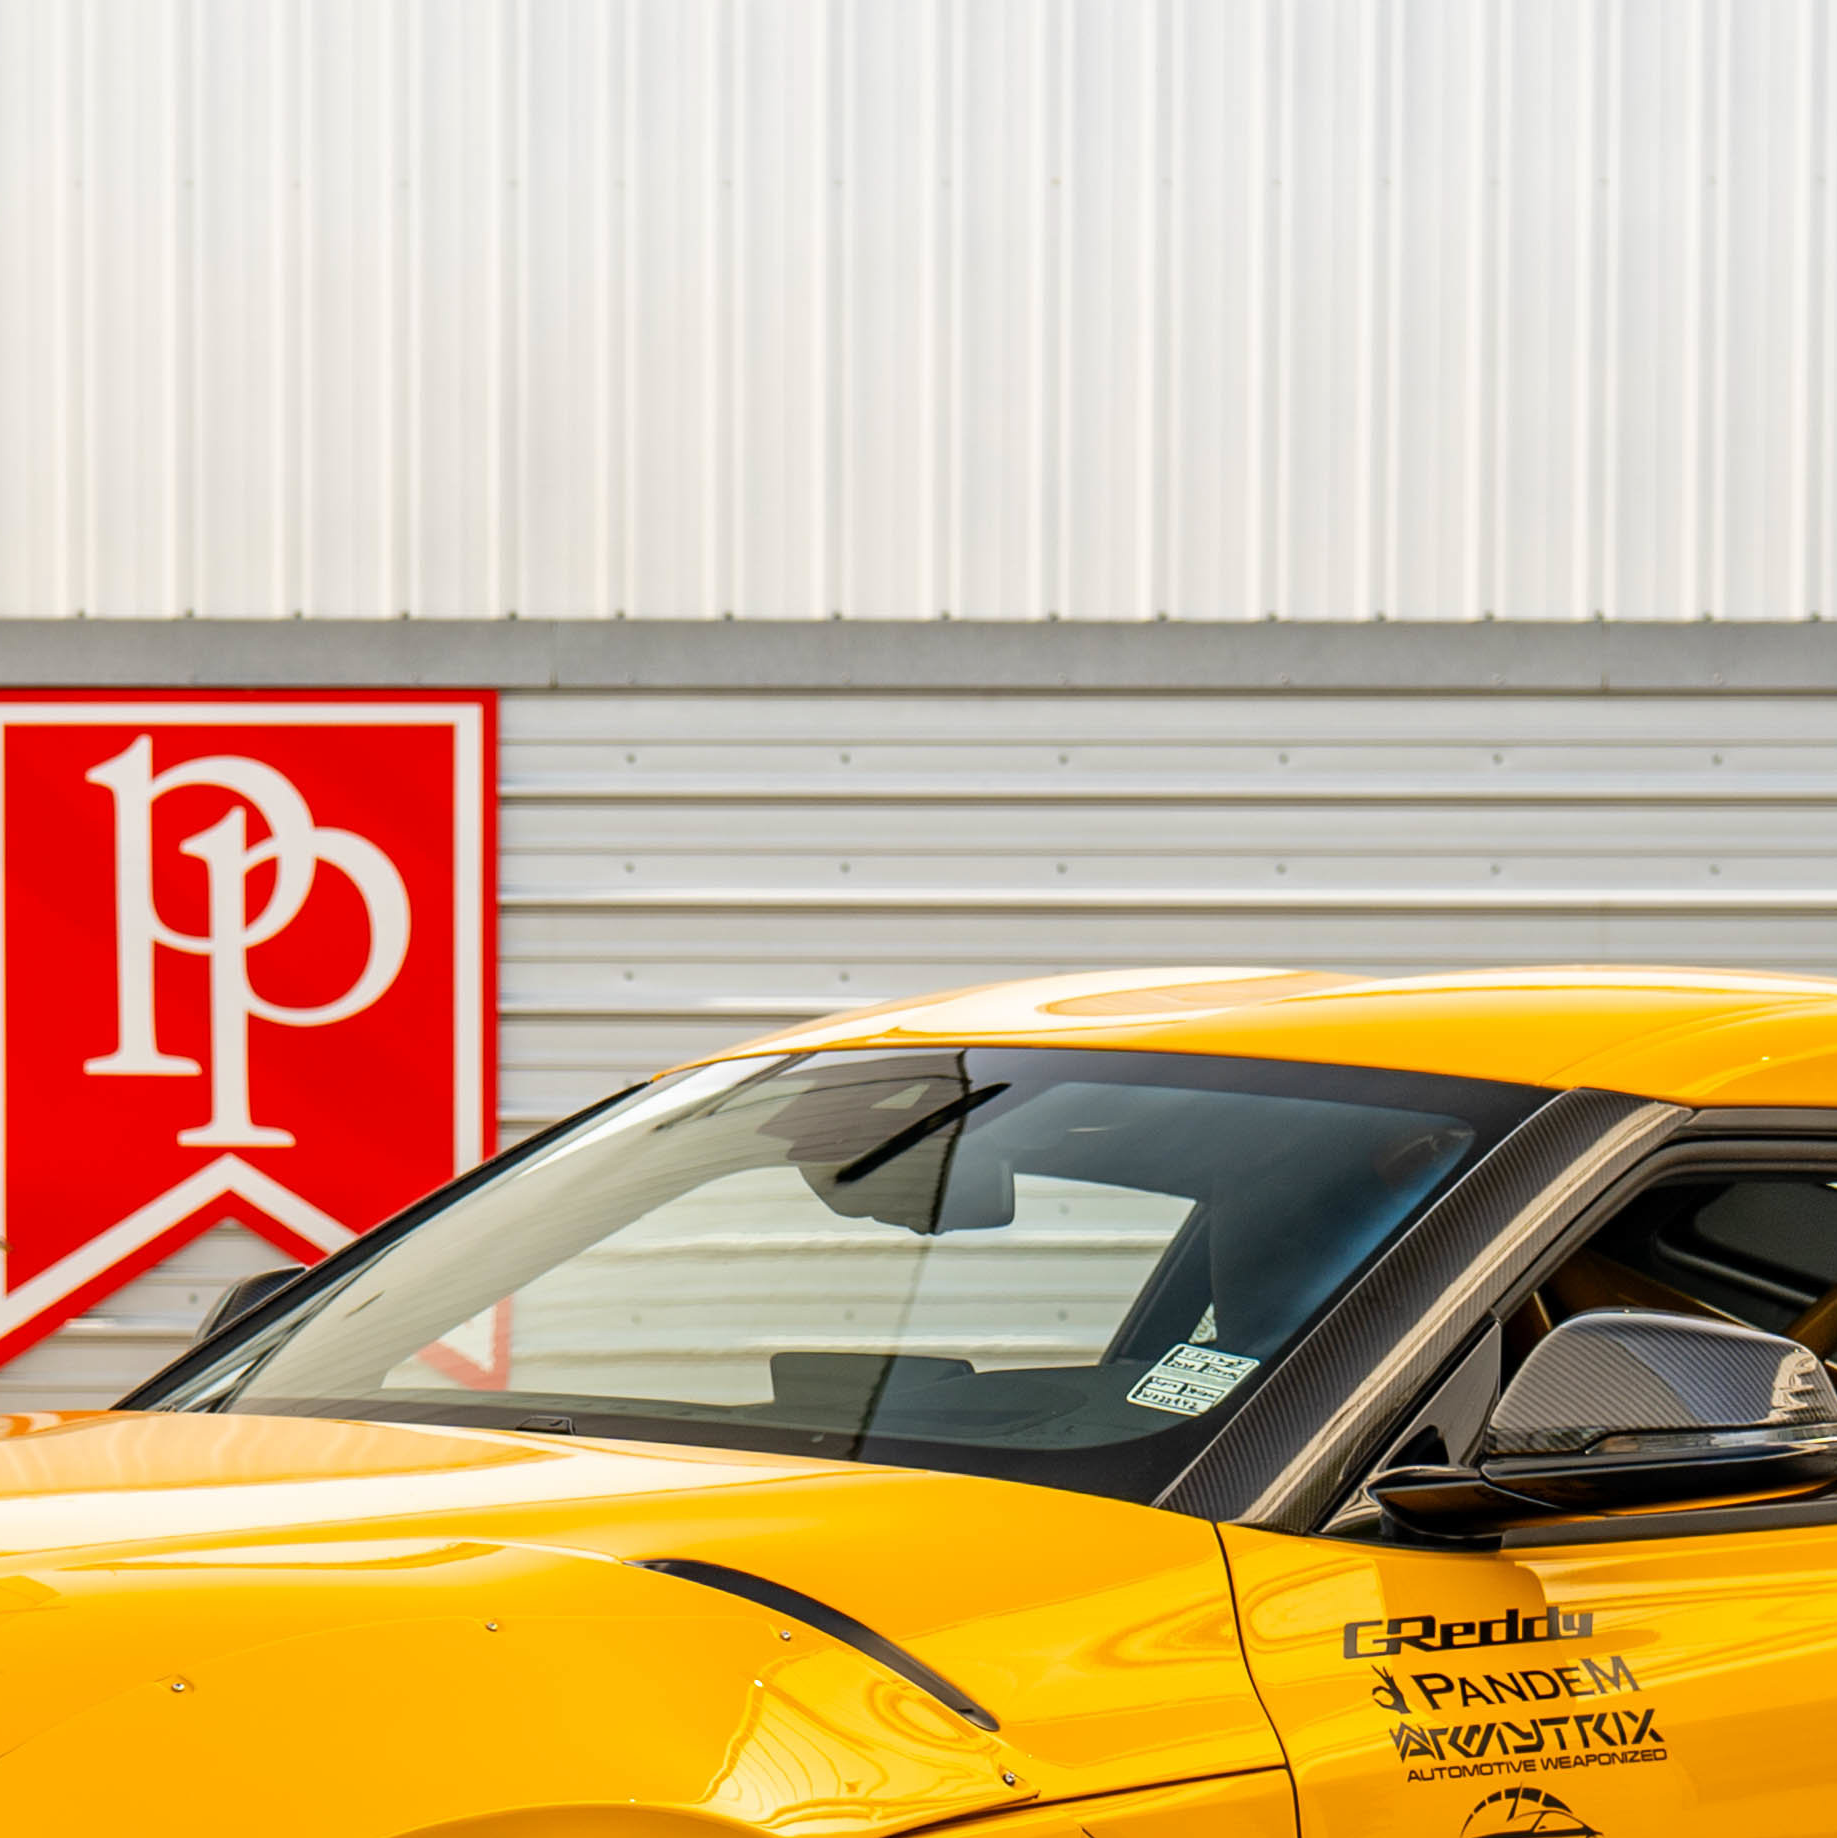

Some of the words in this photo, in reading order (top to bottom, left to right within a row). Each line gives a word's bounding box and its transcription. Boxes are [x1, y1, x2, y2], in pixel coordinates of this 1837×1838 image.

[1343, 1606, 1594, 1659] GReddy
[1411, 1655, 1642, 1711] PANDEM
[1406, 1758, 1537, 1783] AUTOMOTIVE
[1540, 1748, 1668, 1772] WEAPONIZED
